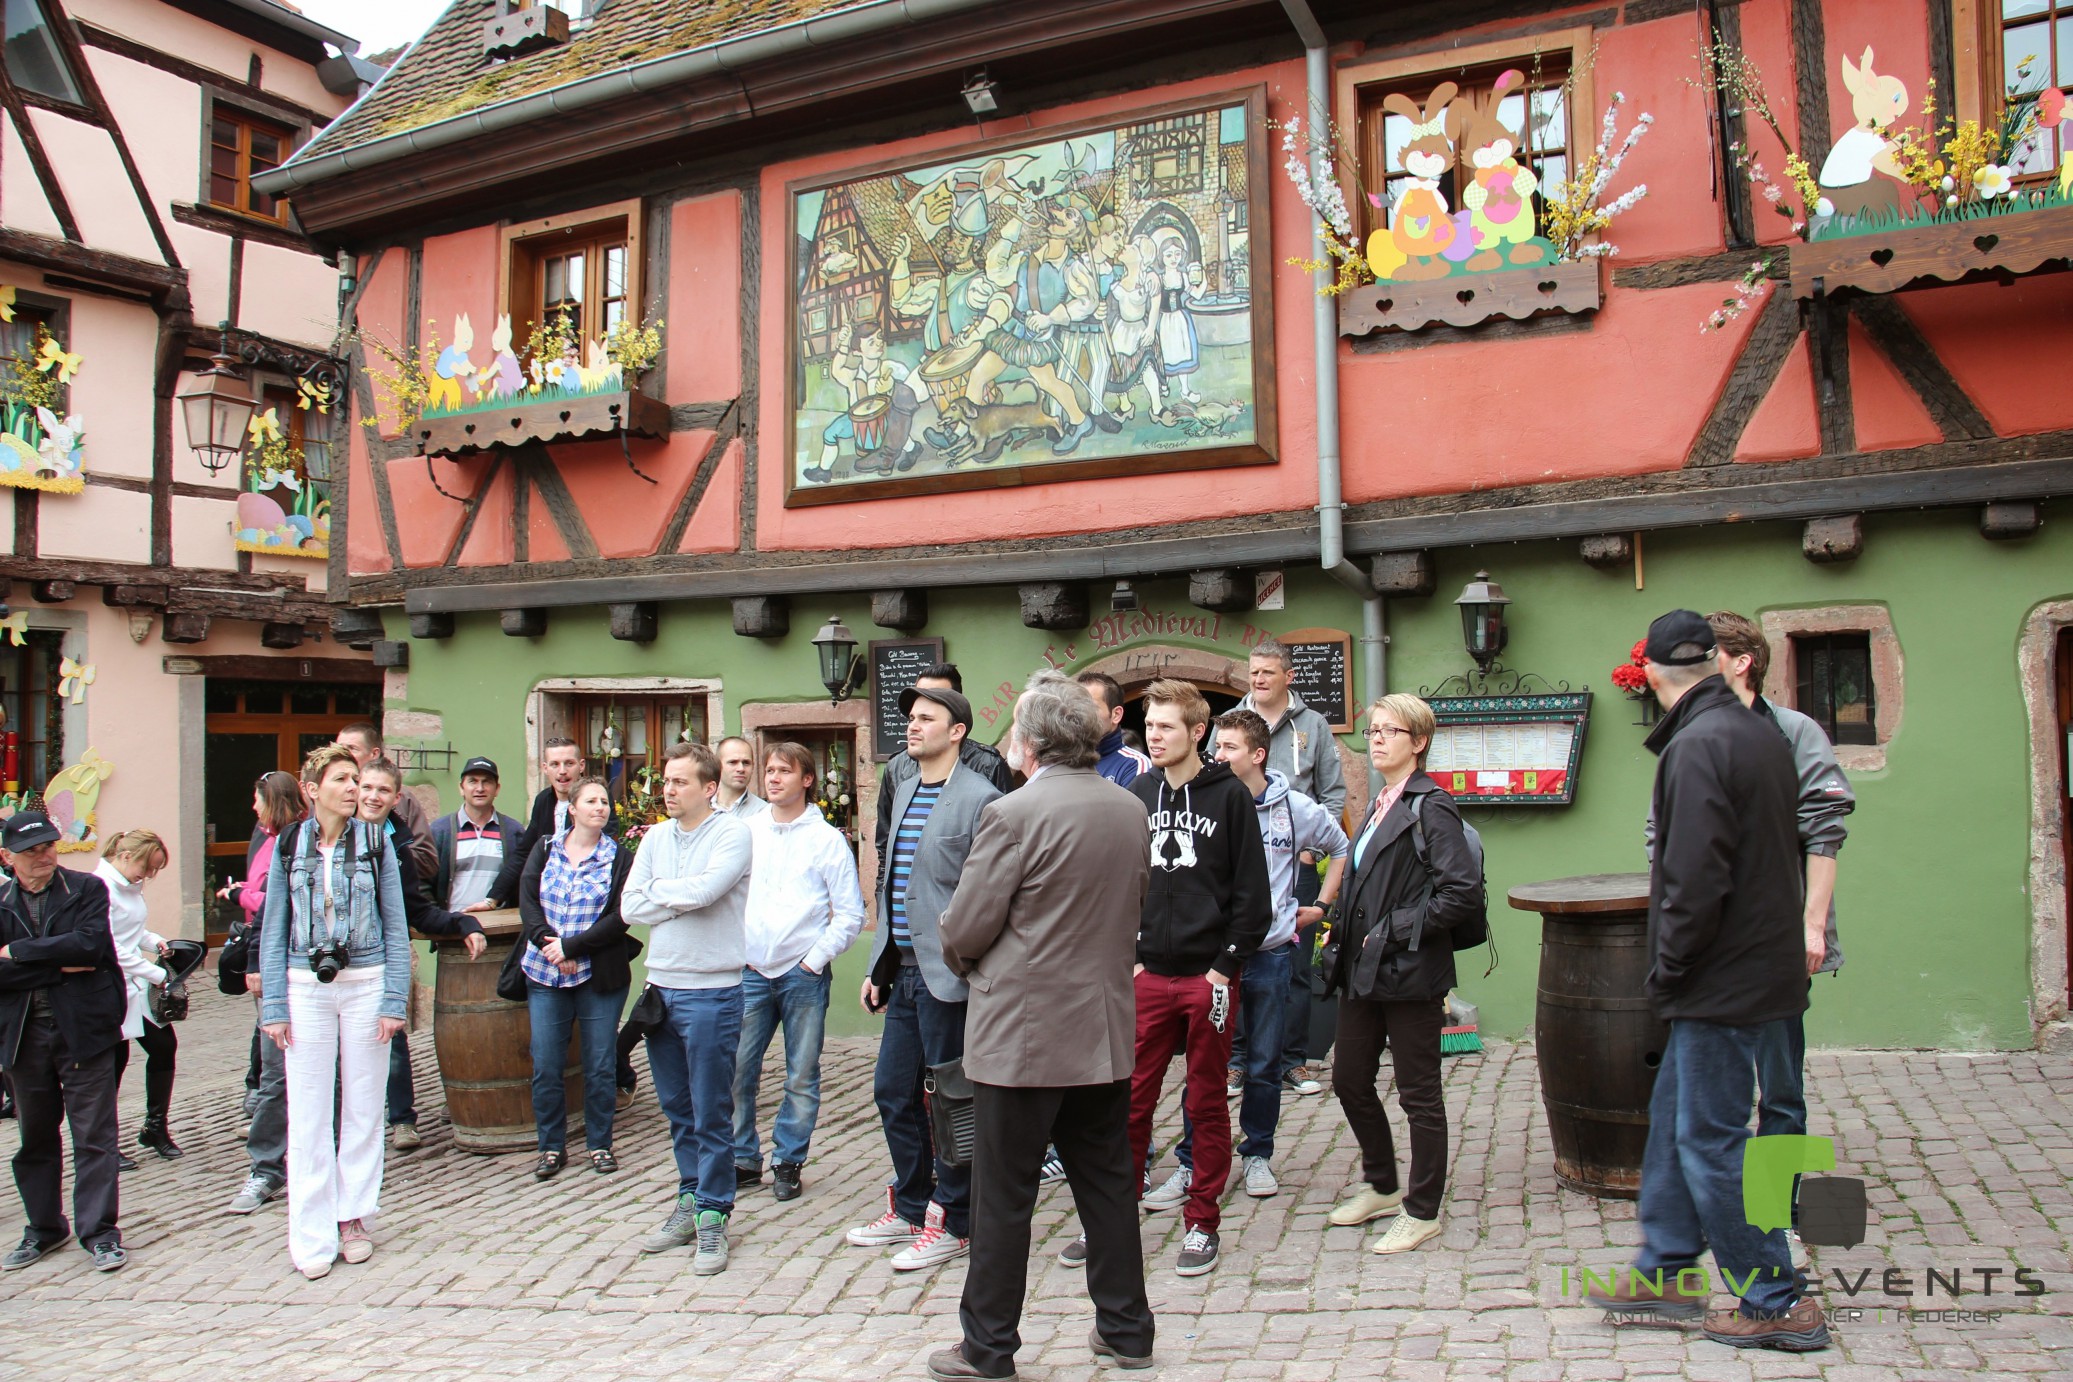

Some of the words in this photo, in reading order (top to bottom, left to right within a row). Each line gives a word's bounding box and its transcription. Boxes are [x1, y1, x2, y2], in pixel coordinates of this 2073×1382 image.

[1257, 574, 1282, 606] LICENCE
[979, 681, 1020, 728] BAR
[1042, 643, 1078, 670] Le
[1088, 606, 1222, 652] Médiéval
[1148, 810, 1218, 838] OOKLYN
